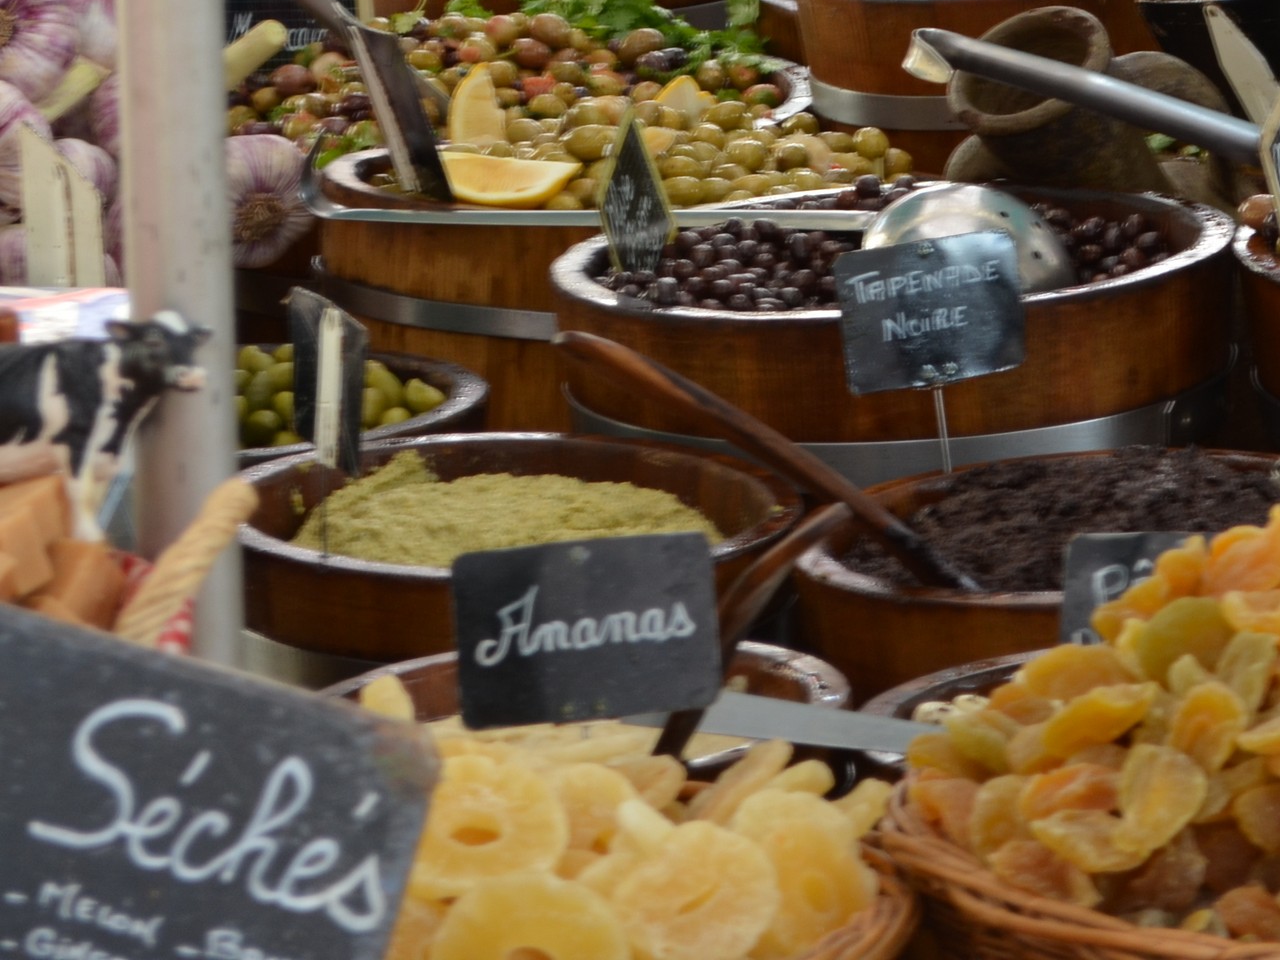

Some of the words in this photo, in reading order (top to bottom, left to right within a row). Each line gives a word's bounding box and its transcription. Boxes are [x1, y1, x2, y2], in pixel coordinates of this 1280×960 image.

[845, 260, 999, 304] TAPENADE
[475, 584, 697, 667] Ananas
[27, 699, 385, 932] Séchés
